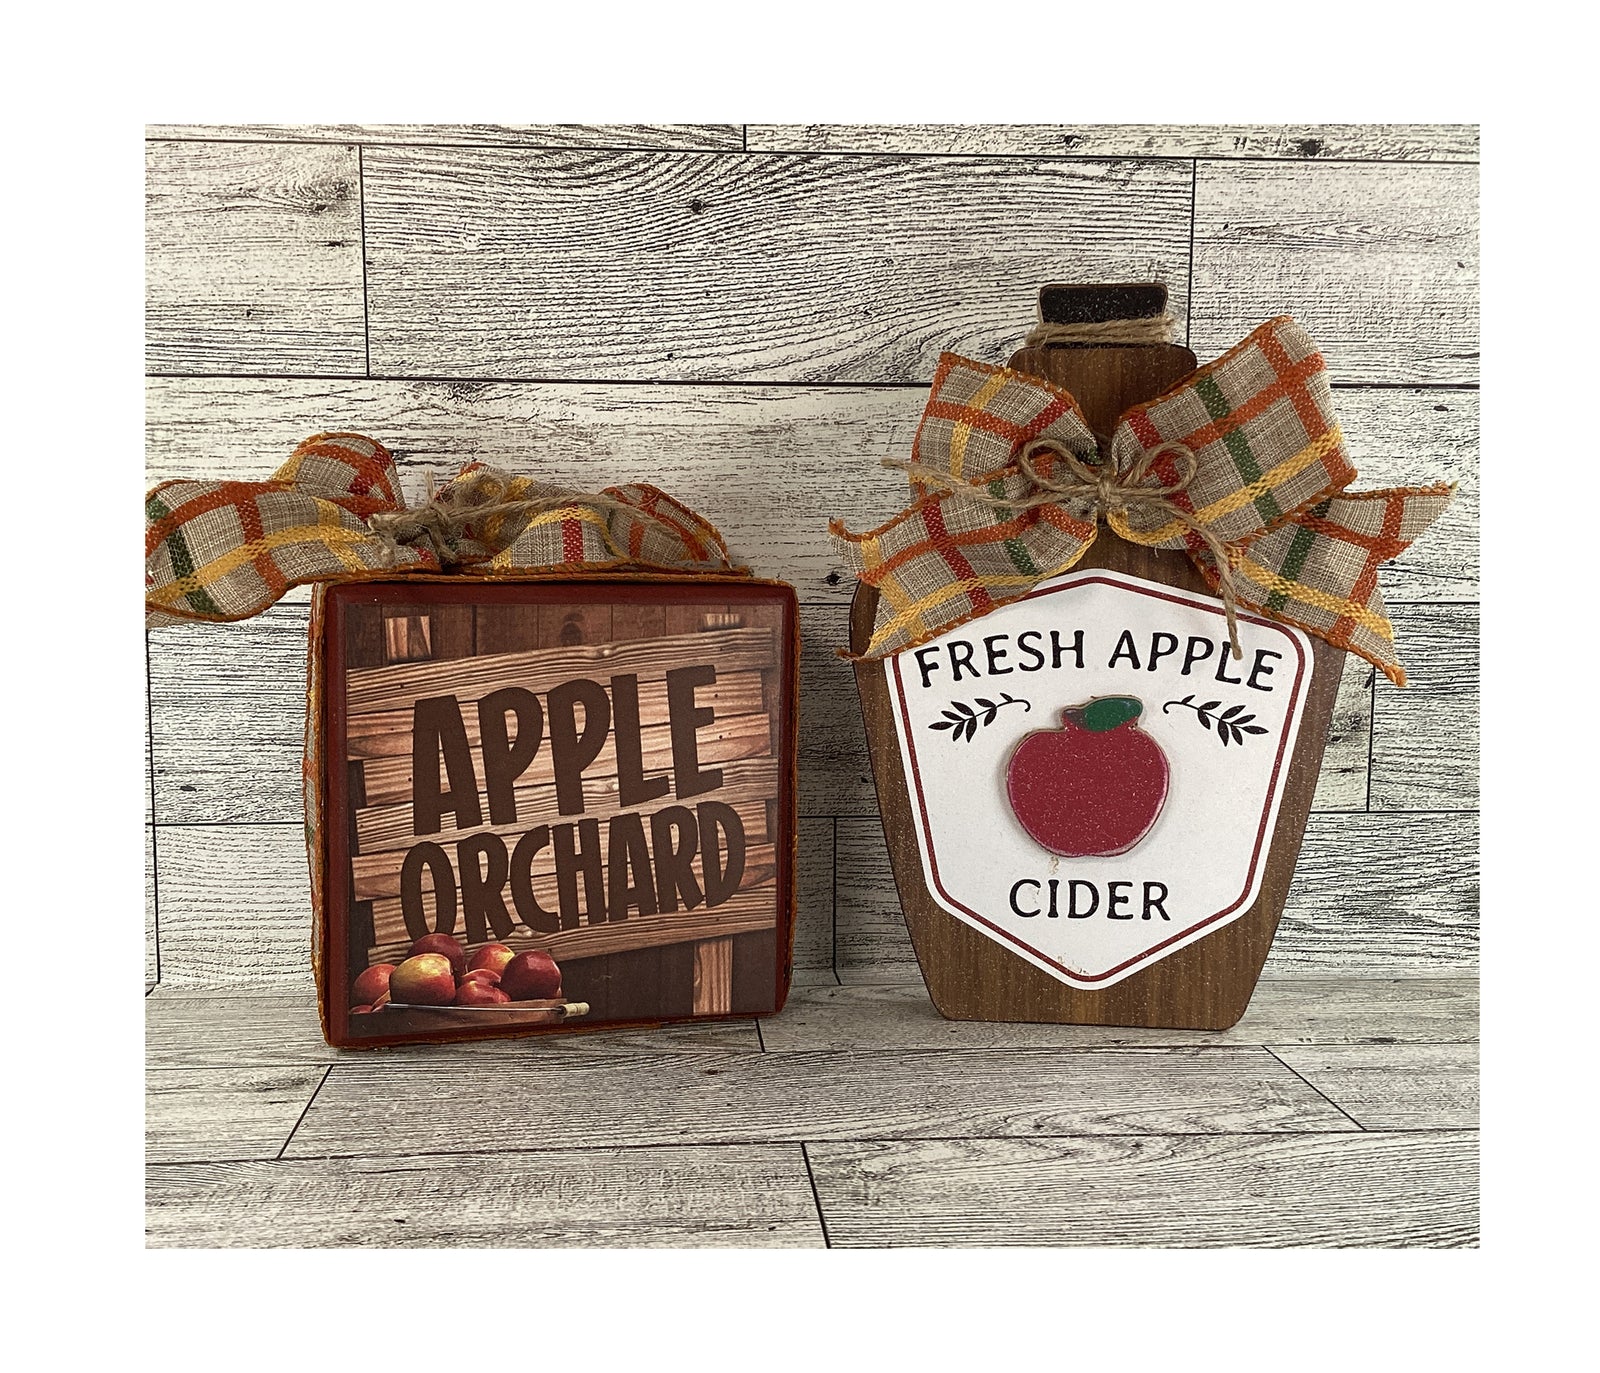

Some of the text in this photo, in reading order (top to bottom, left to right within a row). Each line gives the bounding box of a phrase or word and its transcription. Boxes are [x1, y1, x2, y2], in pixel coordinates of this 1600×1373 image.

[913, 629, 1284, 692] FRESH APPLE
[412, 664, 724, 836] APPLE
[400, 800, 746, 945] ORCHARD
[1009, 878, 1172, 921] CIDER
